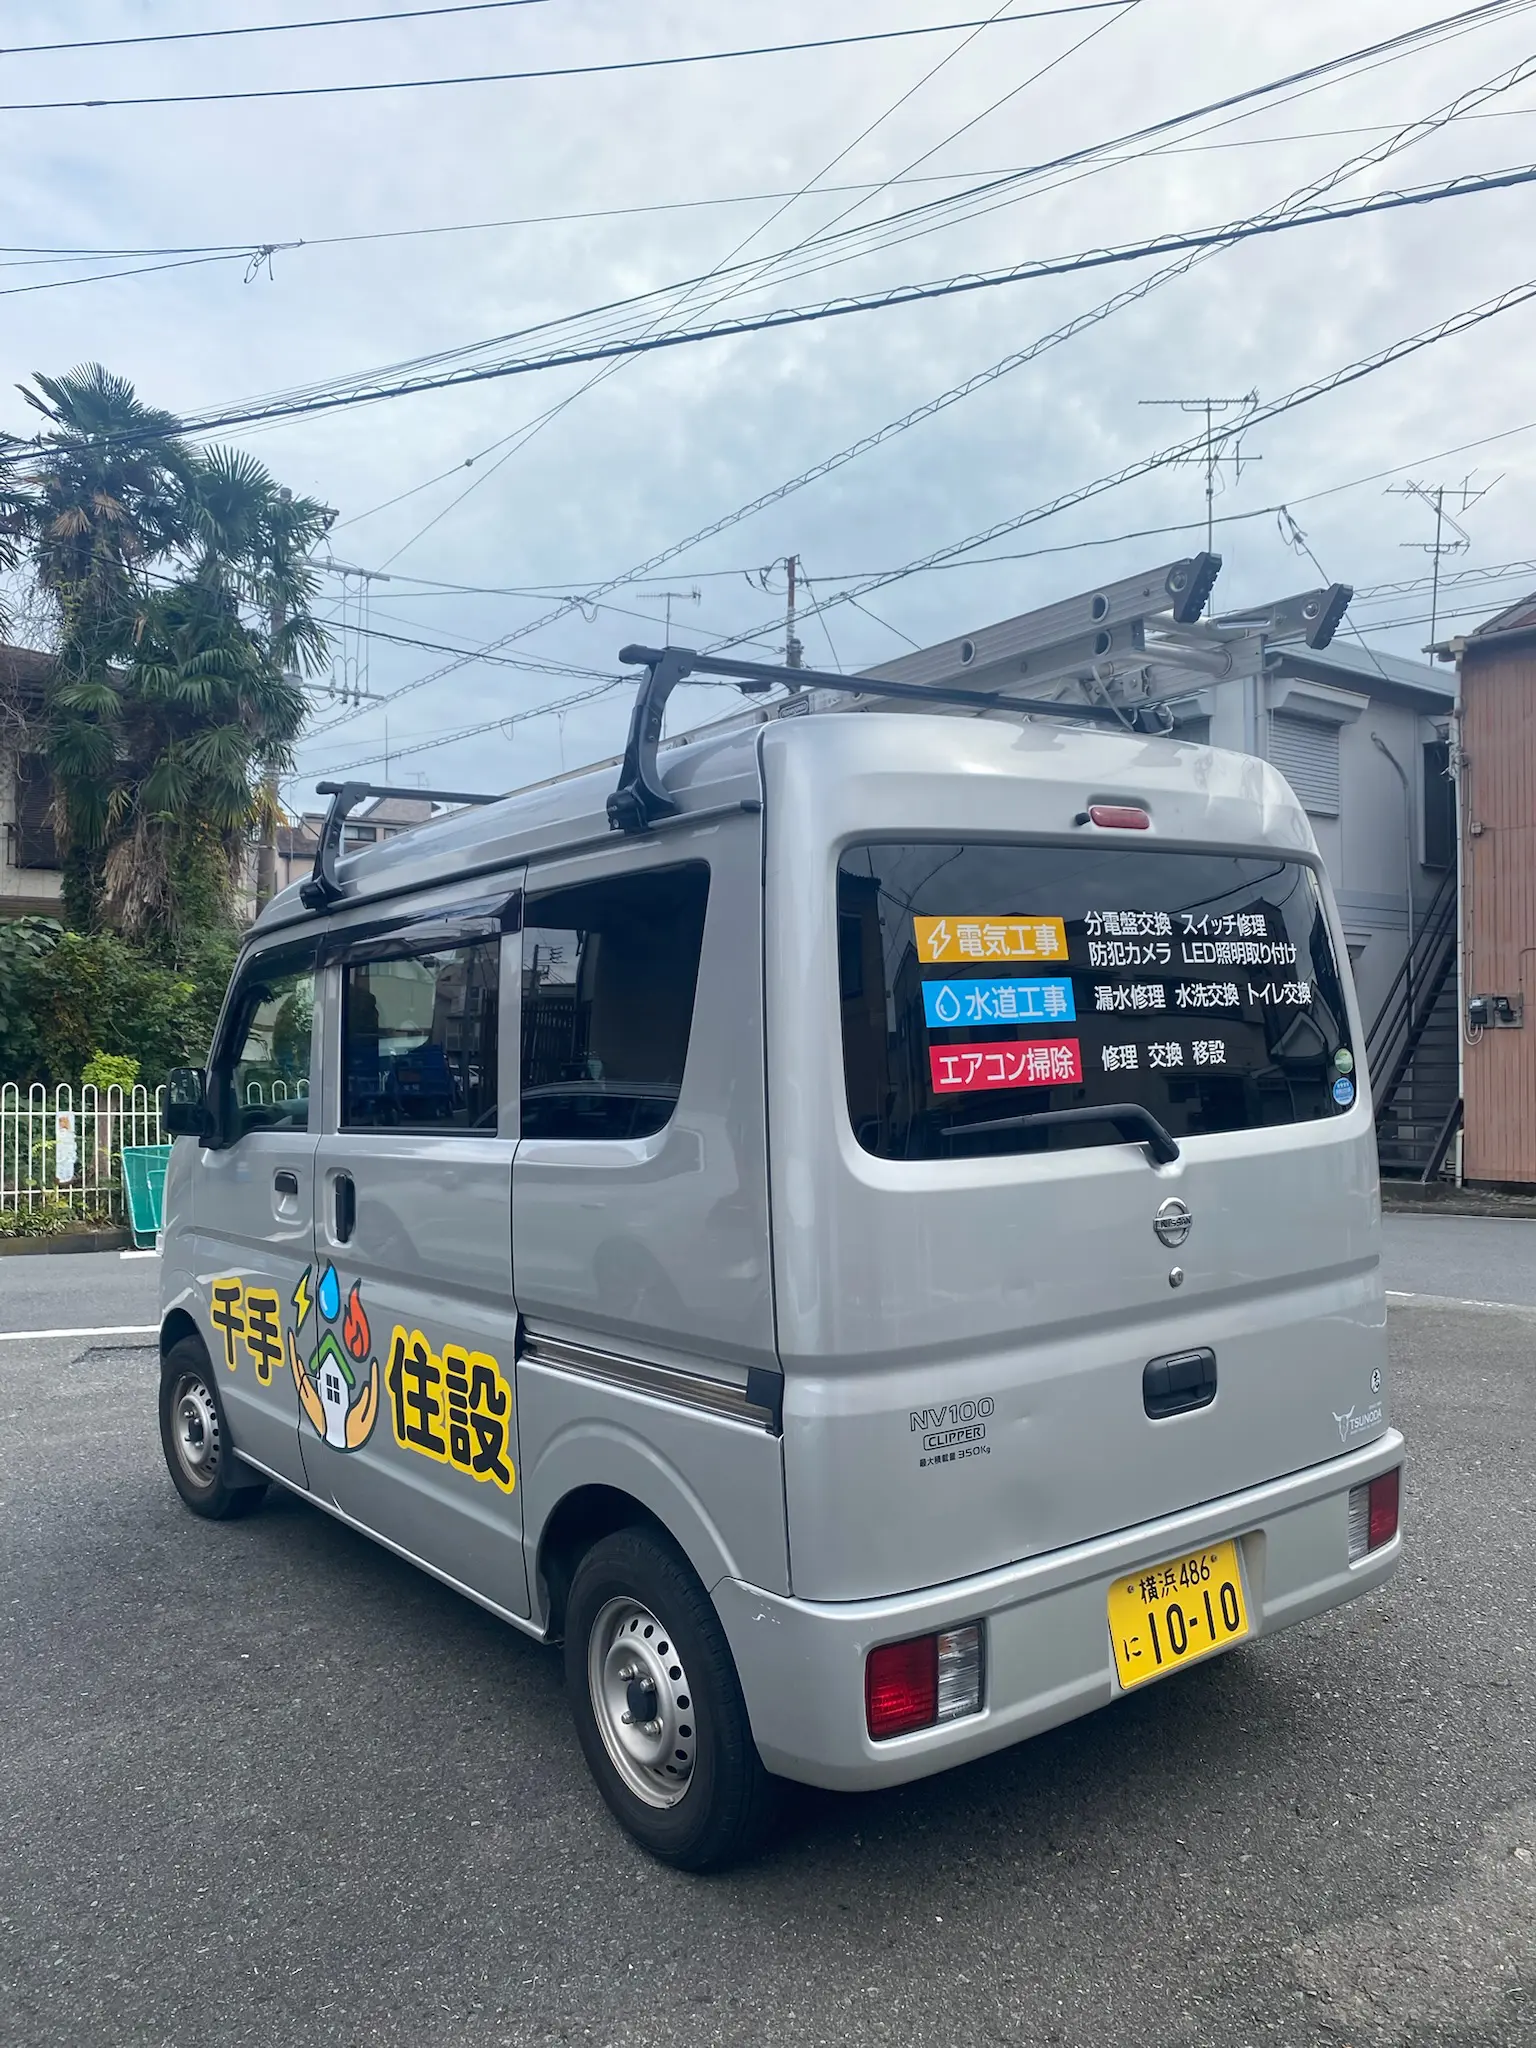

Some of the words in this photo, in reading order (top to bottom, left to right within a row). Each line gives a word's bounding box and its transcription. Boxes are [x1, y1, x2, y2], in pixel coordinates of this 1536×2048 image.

[957, 923, 1060, 957] 電気工事
[1084, 911, 1172, 937] 分電盤交換
[1181, 914, 1267, 937] スイッチ修理
[1088, 941, 1172, 967] 防犯カメラ
[1181, 941, 1297, 966] LED照明取り付け
[967, 984, 1068, 1020] 水道工事
[1094, 983, 1166, 1012] 漏水修理
[1175, 982, 1240, 1008] 水洗交換
[1248, 980, 1312, 1006] トイレ交換
[939, 1045, 1075, 1085] エアコン掃除
[1101, 1044, 1138, 1071] 修理
[1148, 1042, 1183, 1067] 交換
[1192, 1039, 1227, 1065] 移設
[1160, 1216, 1191, 1228] NISSAN
[212, 1282, 284, 1383] 千手
[387, 1332, 512, 1488] 住設
[909, 1396, 995, 1432] NV100
[928, 1427, 981, 1448] CLIPPER
[1139, 1568, 1178, 1604] 横浜
[1179, 1555, 1210, 1588] 486
[1123, 1636, 1142, 1662] に
[1148, 1581, 1240, 1665] 10-10
